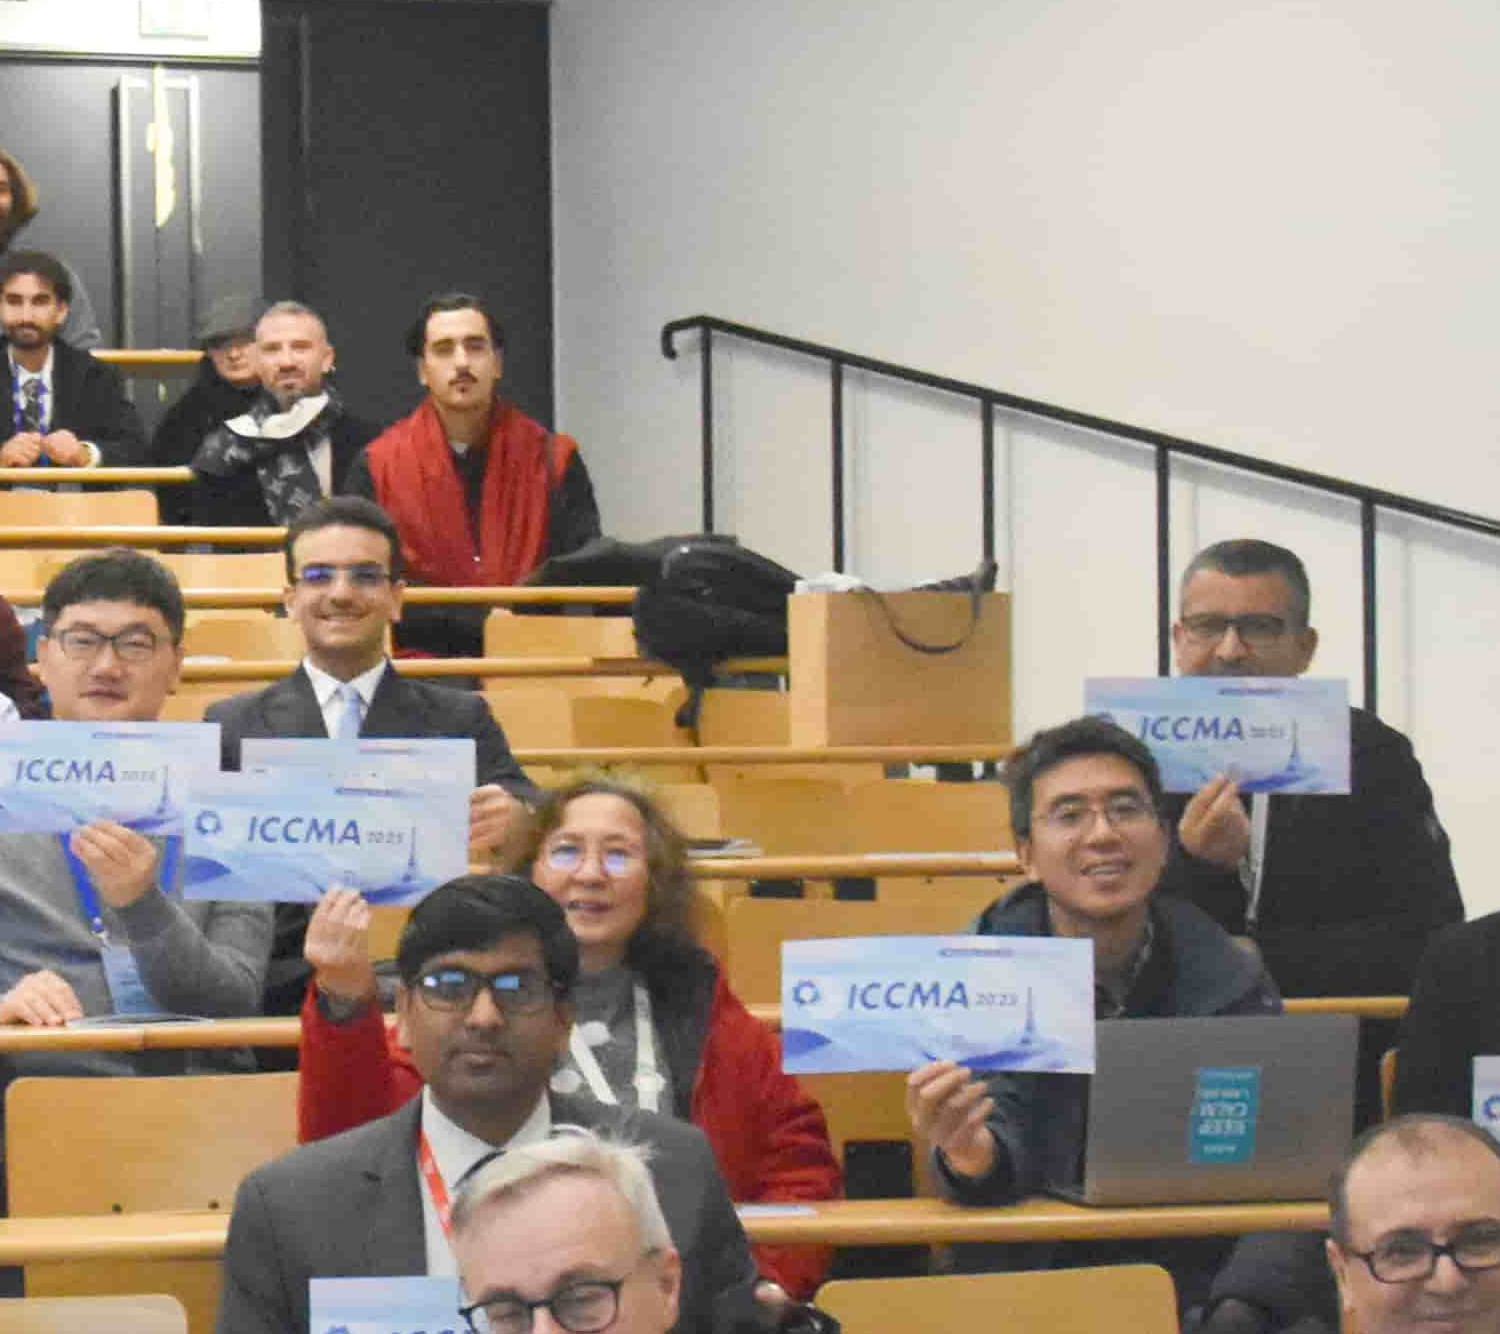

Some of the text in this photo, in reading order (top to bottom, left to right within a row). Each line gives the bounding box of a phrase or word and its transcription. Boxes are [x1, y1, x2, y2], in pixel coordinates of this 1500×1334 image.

[1138, 714, 1245, 743] ICCMA
[15, 758, 117, 785] ICCMA
[247, 816, 362, 846] ICCMA
[847, 980, 970, 1011] ICCMA
